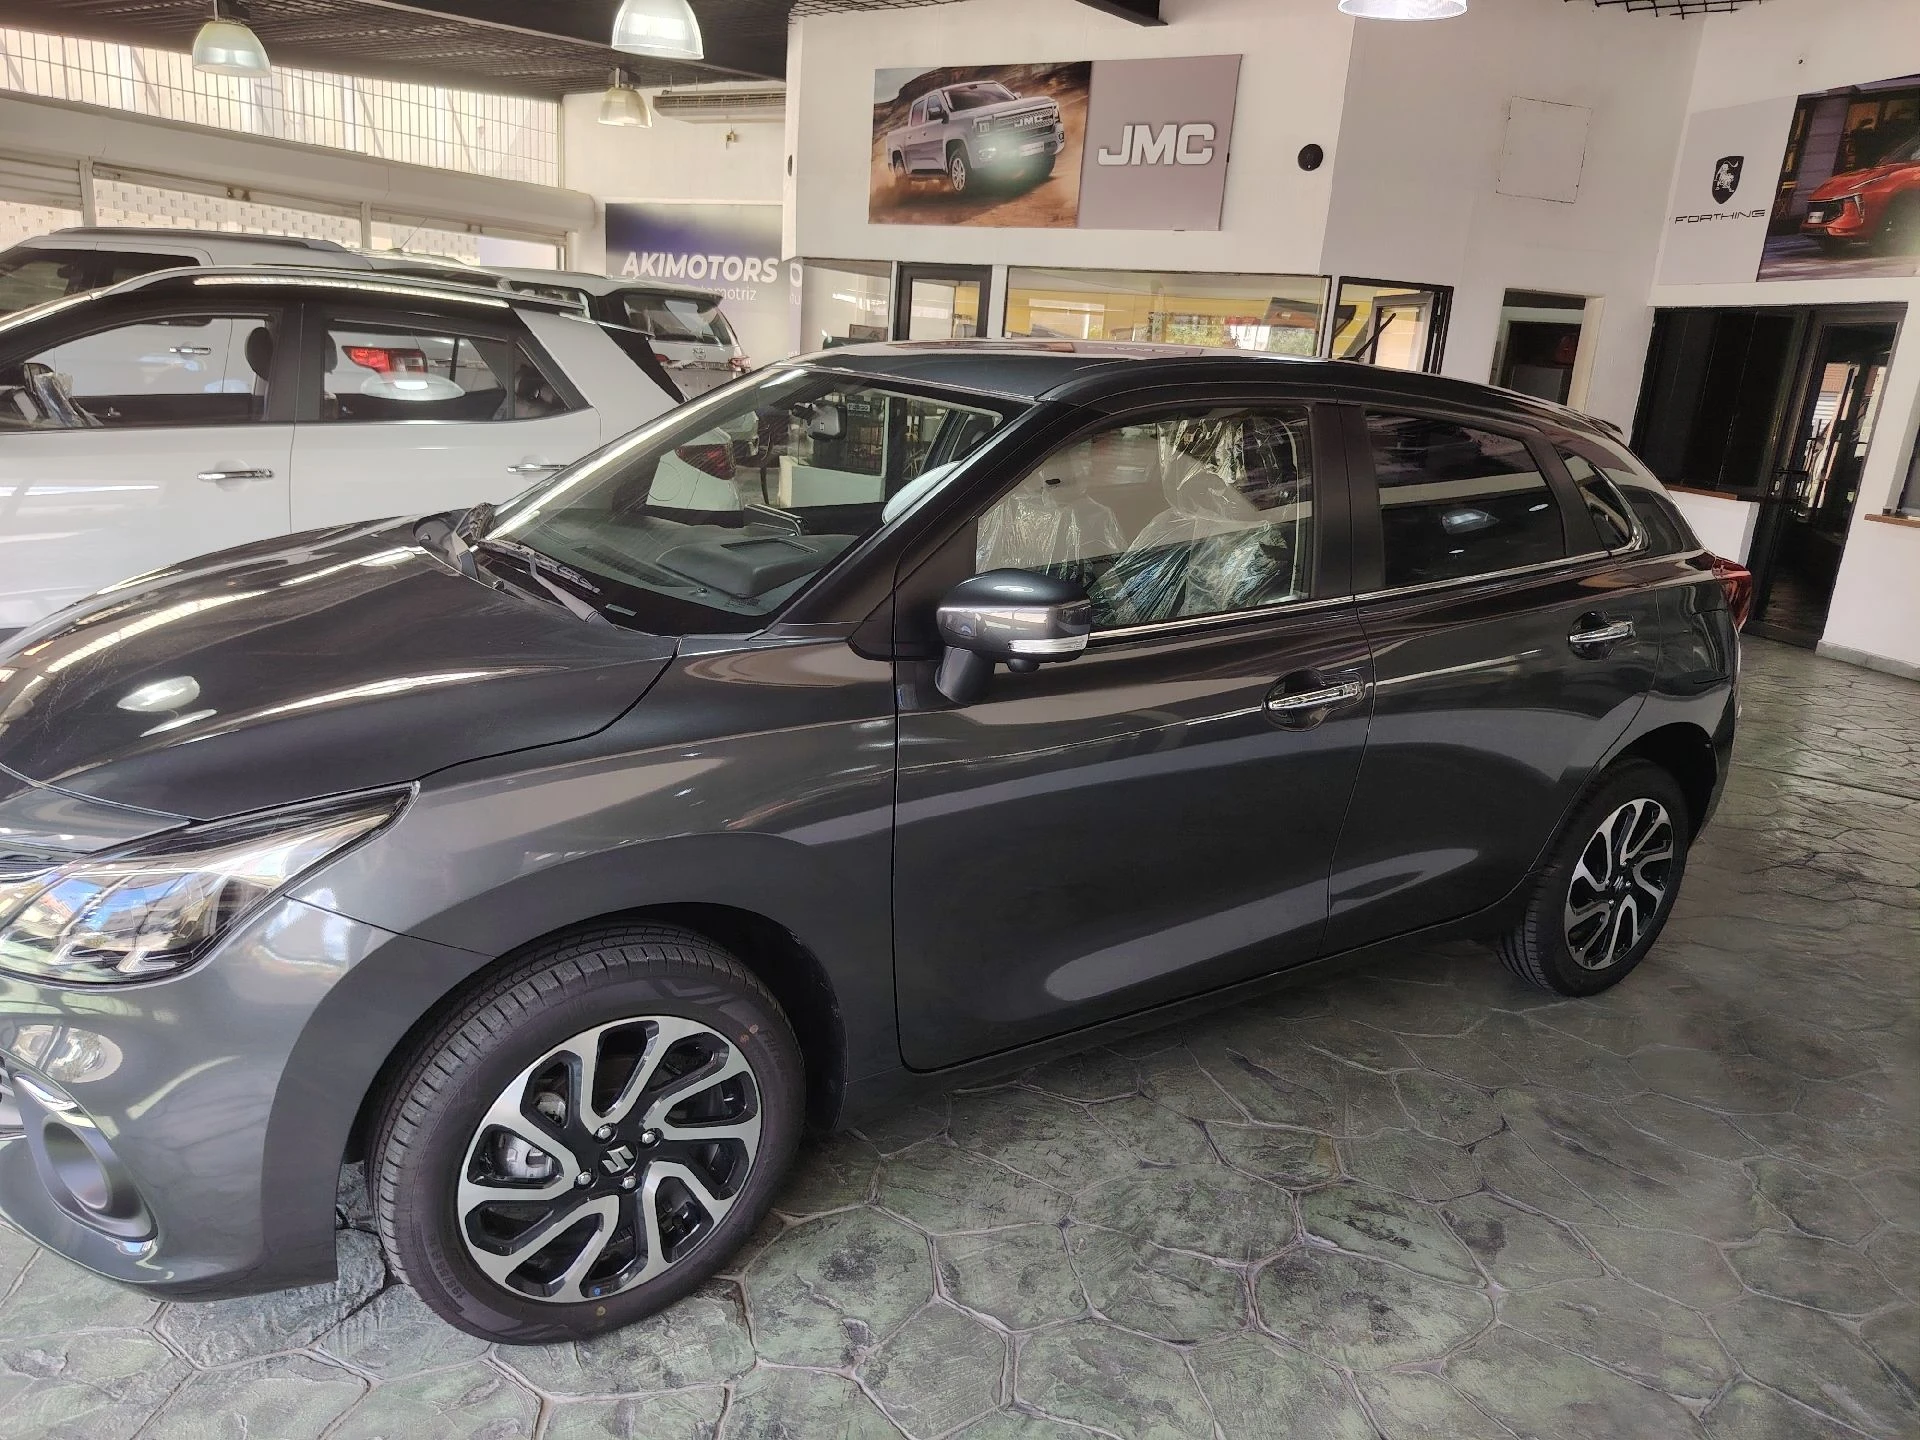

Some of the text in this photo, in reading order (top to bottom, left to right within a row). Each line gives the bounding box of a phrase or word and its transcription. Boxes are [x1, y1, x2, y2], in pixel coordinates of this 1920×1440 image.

[1097, 123, 1216, 166] JMC
[1674, 209, 1766, 224] FORTHING
[621, 251, 780, 283] AKIMOTORS
